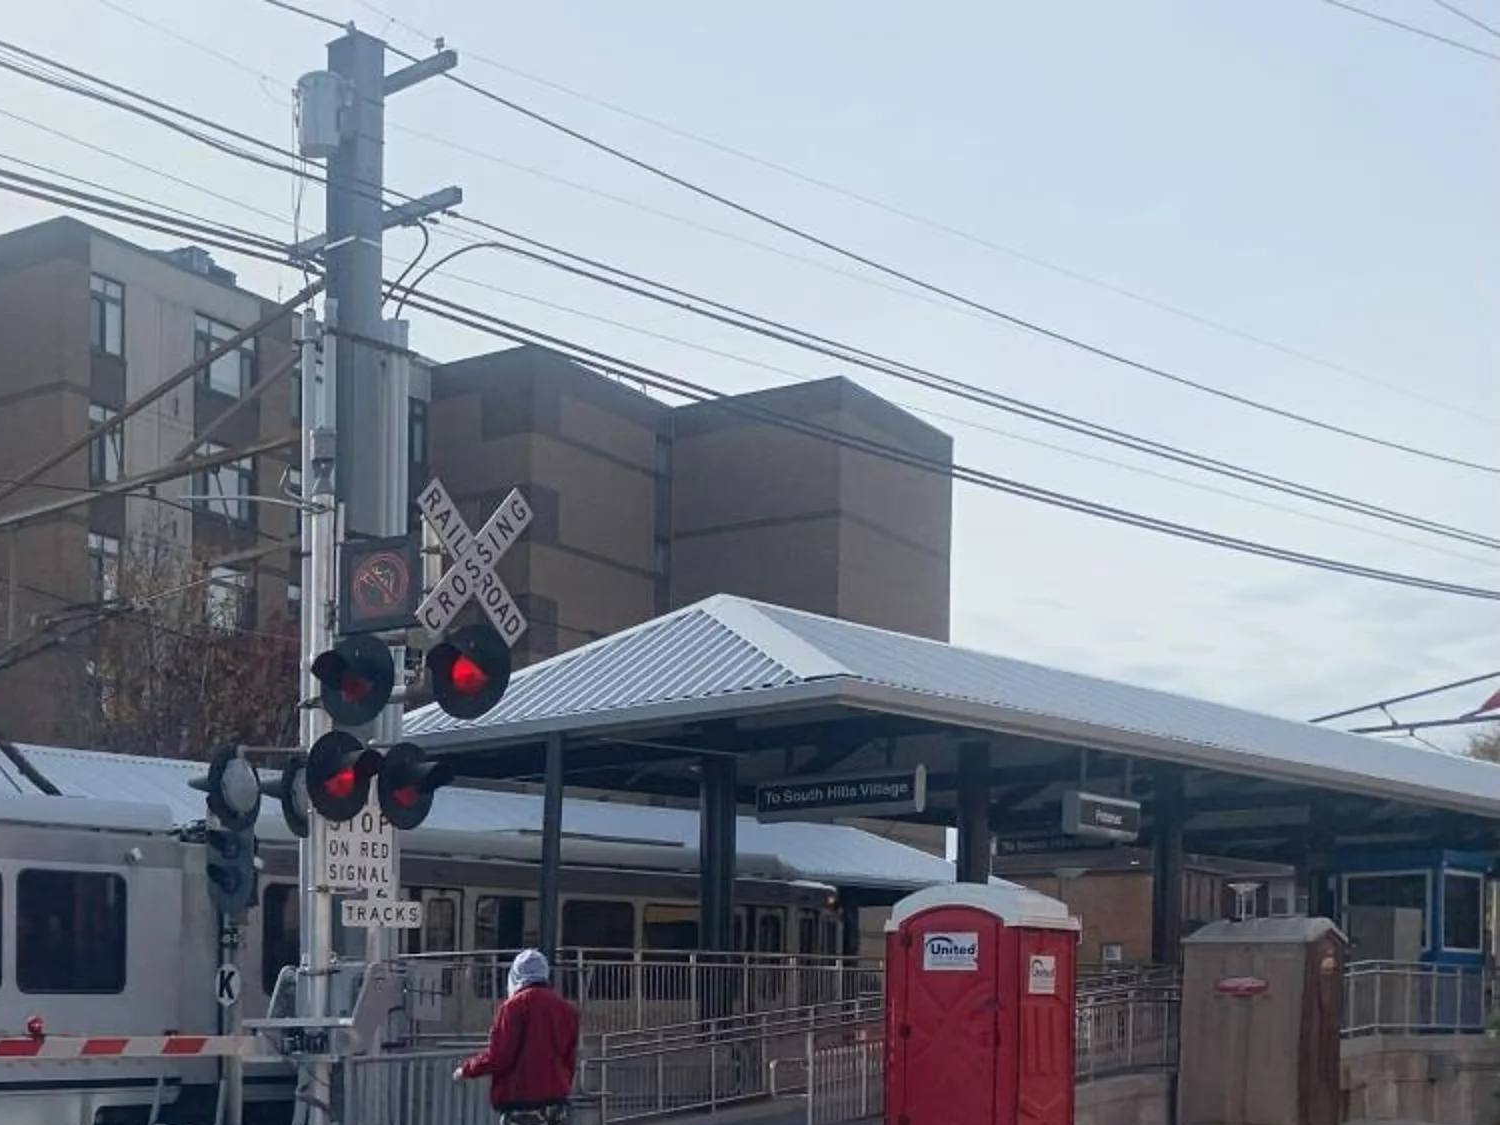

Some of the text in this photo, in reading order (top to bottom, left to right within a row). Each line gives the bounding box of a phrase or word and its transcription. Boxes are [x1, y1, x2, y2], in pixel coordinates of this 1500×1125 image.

[424, 488, 520, 635] RAIL ROAD
[424, 501, 527, 630] CROSSING
[765, 782, 909, 804] To South Hills Village
[329, 840, 389, 859] ON RED
[329, 863, 389, 883] SIGNAL
[345, 906, 419, 922] TRACKS
[931, 943, 977, 955] United
[218, 970, 236, 1000] K
